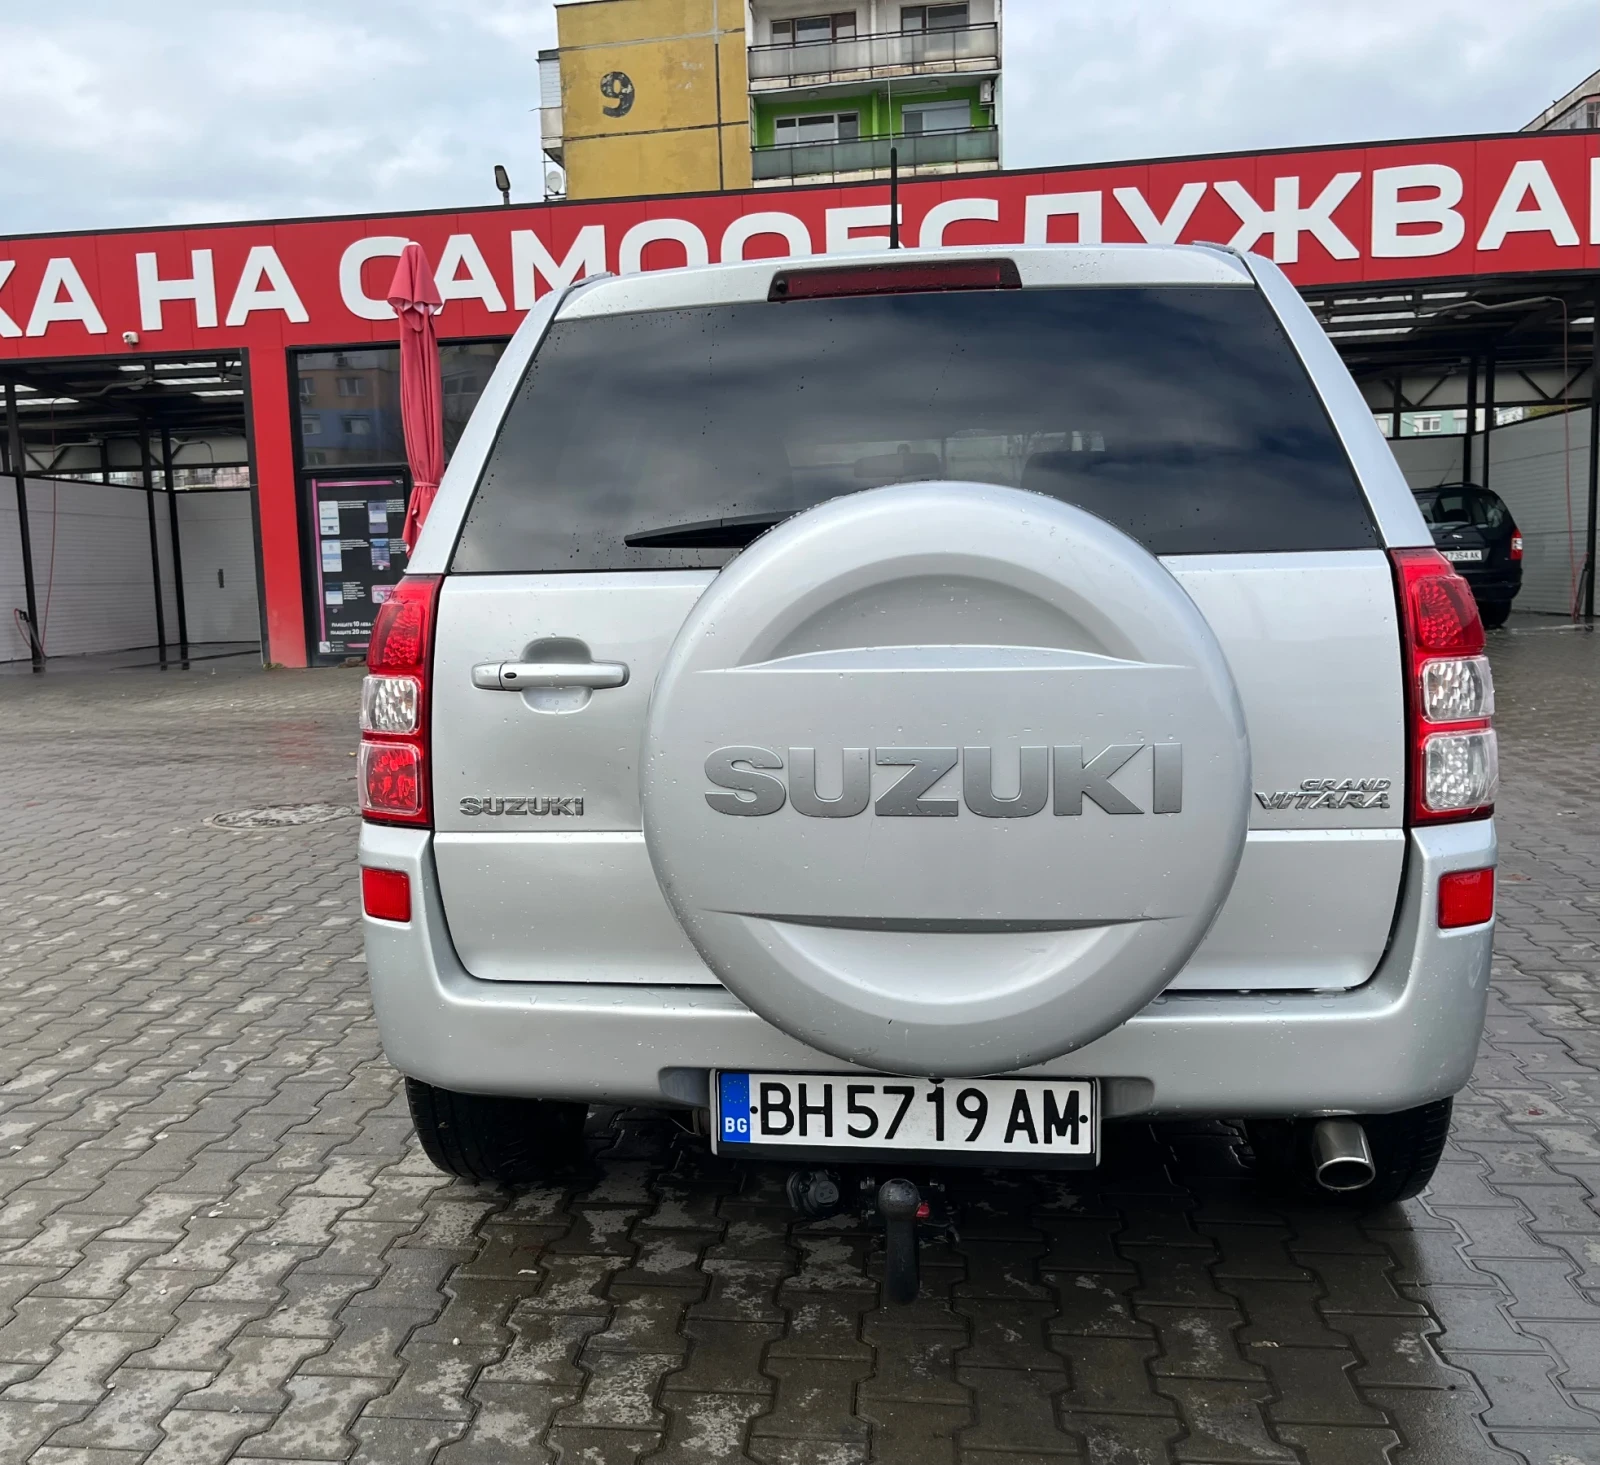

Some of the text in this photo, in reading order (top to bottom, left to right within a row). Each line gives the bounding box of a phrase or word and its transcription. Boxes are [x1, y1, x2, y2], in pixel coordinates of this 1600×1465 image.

[601, 71, 635, 118] 9
[0, 159, 1600, 338] А НА САМООБСЛУЖВА
[704, 743, 1183, 819] SUZUKI
[1300, 778, 1391, 791] GRAND
[459, 796, 584, 817] SUZUKI
[1255, 790, 1391, 809] VITARA
[724, 1117, 748, 1134] BG
